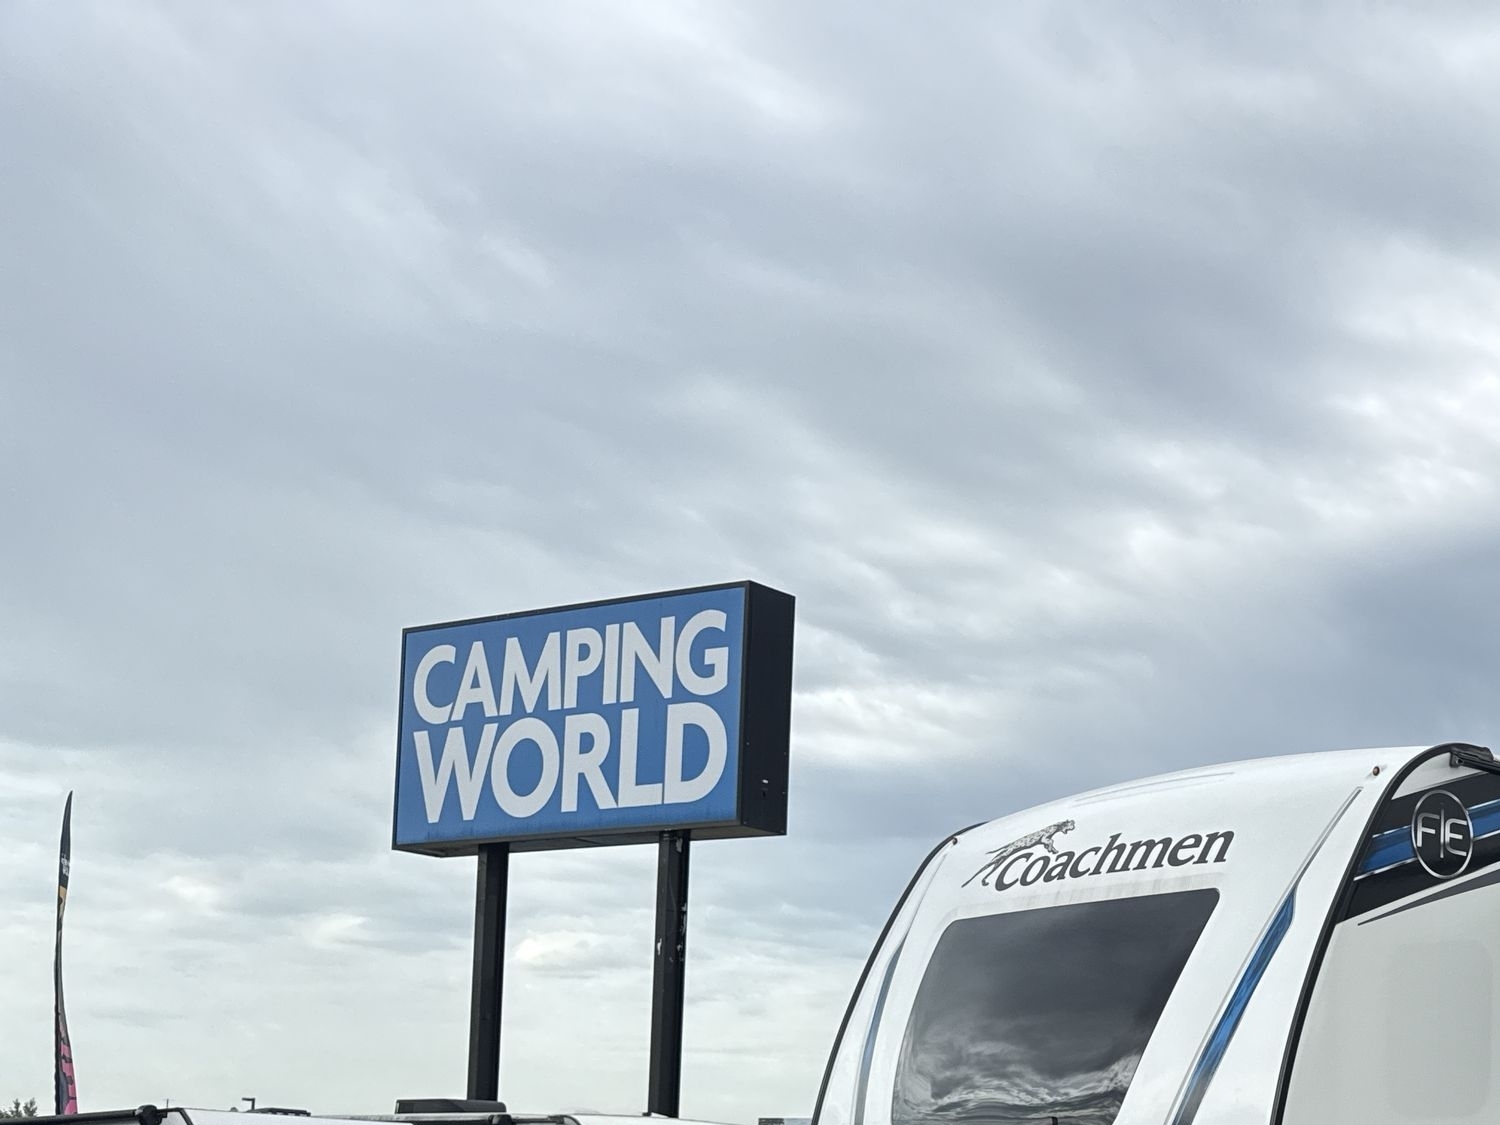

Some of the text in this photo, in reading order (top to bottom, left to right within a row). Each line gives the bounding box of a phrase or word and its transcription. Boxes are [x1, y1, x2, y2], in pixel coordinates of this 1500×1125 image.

[413, 609, 729, 724] CAMPING
[413, 702, 728, 823] WORLD
[995, 830, 1235, 892] Coachmen
